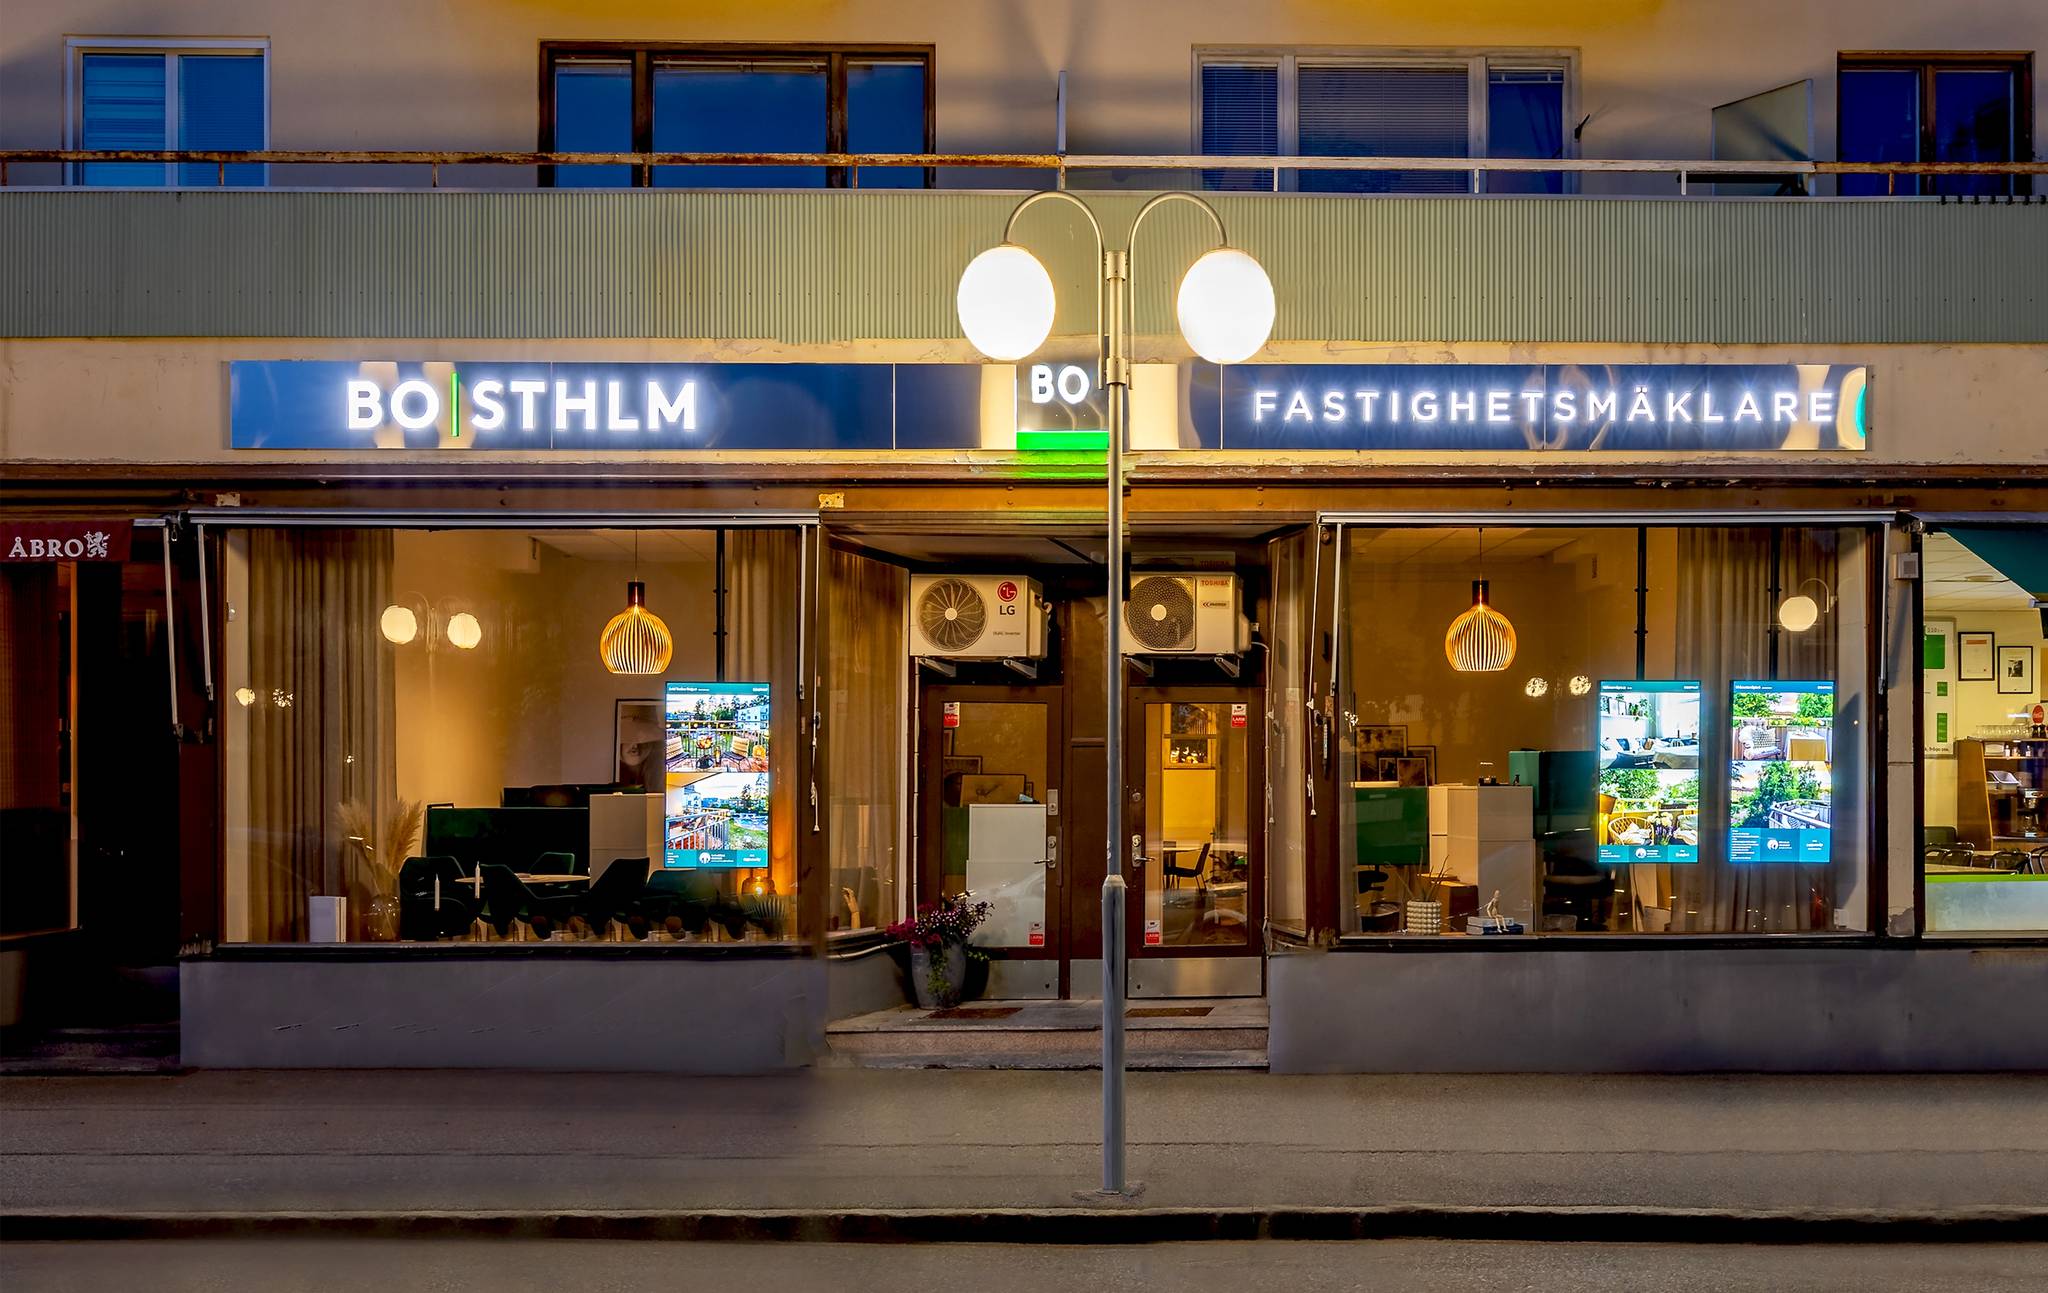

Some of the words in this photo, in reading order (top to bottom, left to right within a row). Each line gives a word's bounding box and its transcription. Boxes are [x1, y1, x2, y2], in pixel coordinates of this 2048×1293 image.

[1031, 365, 1090, 404] BO
[347, 380, 440, 429] BO
[470, 380, 695, 430] STHLM
[1254, 387, 1833, 422] FASTIGHETSMÄKLARE
[8, 536, 84, 557] ÅBRO
[999, 605, 1016, 616] LG
